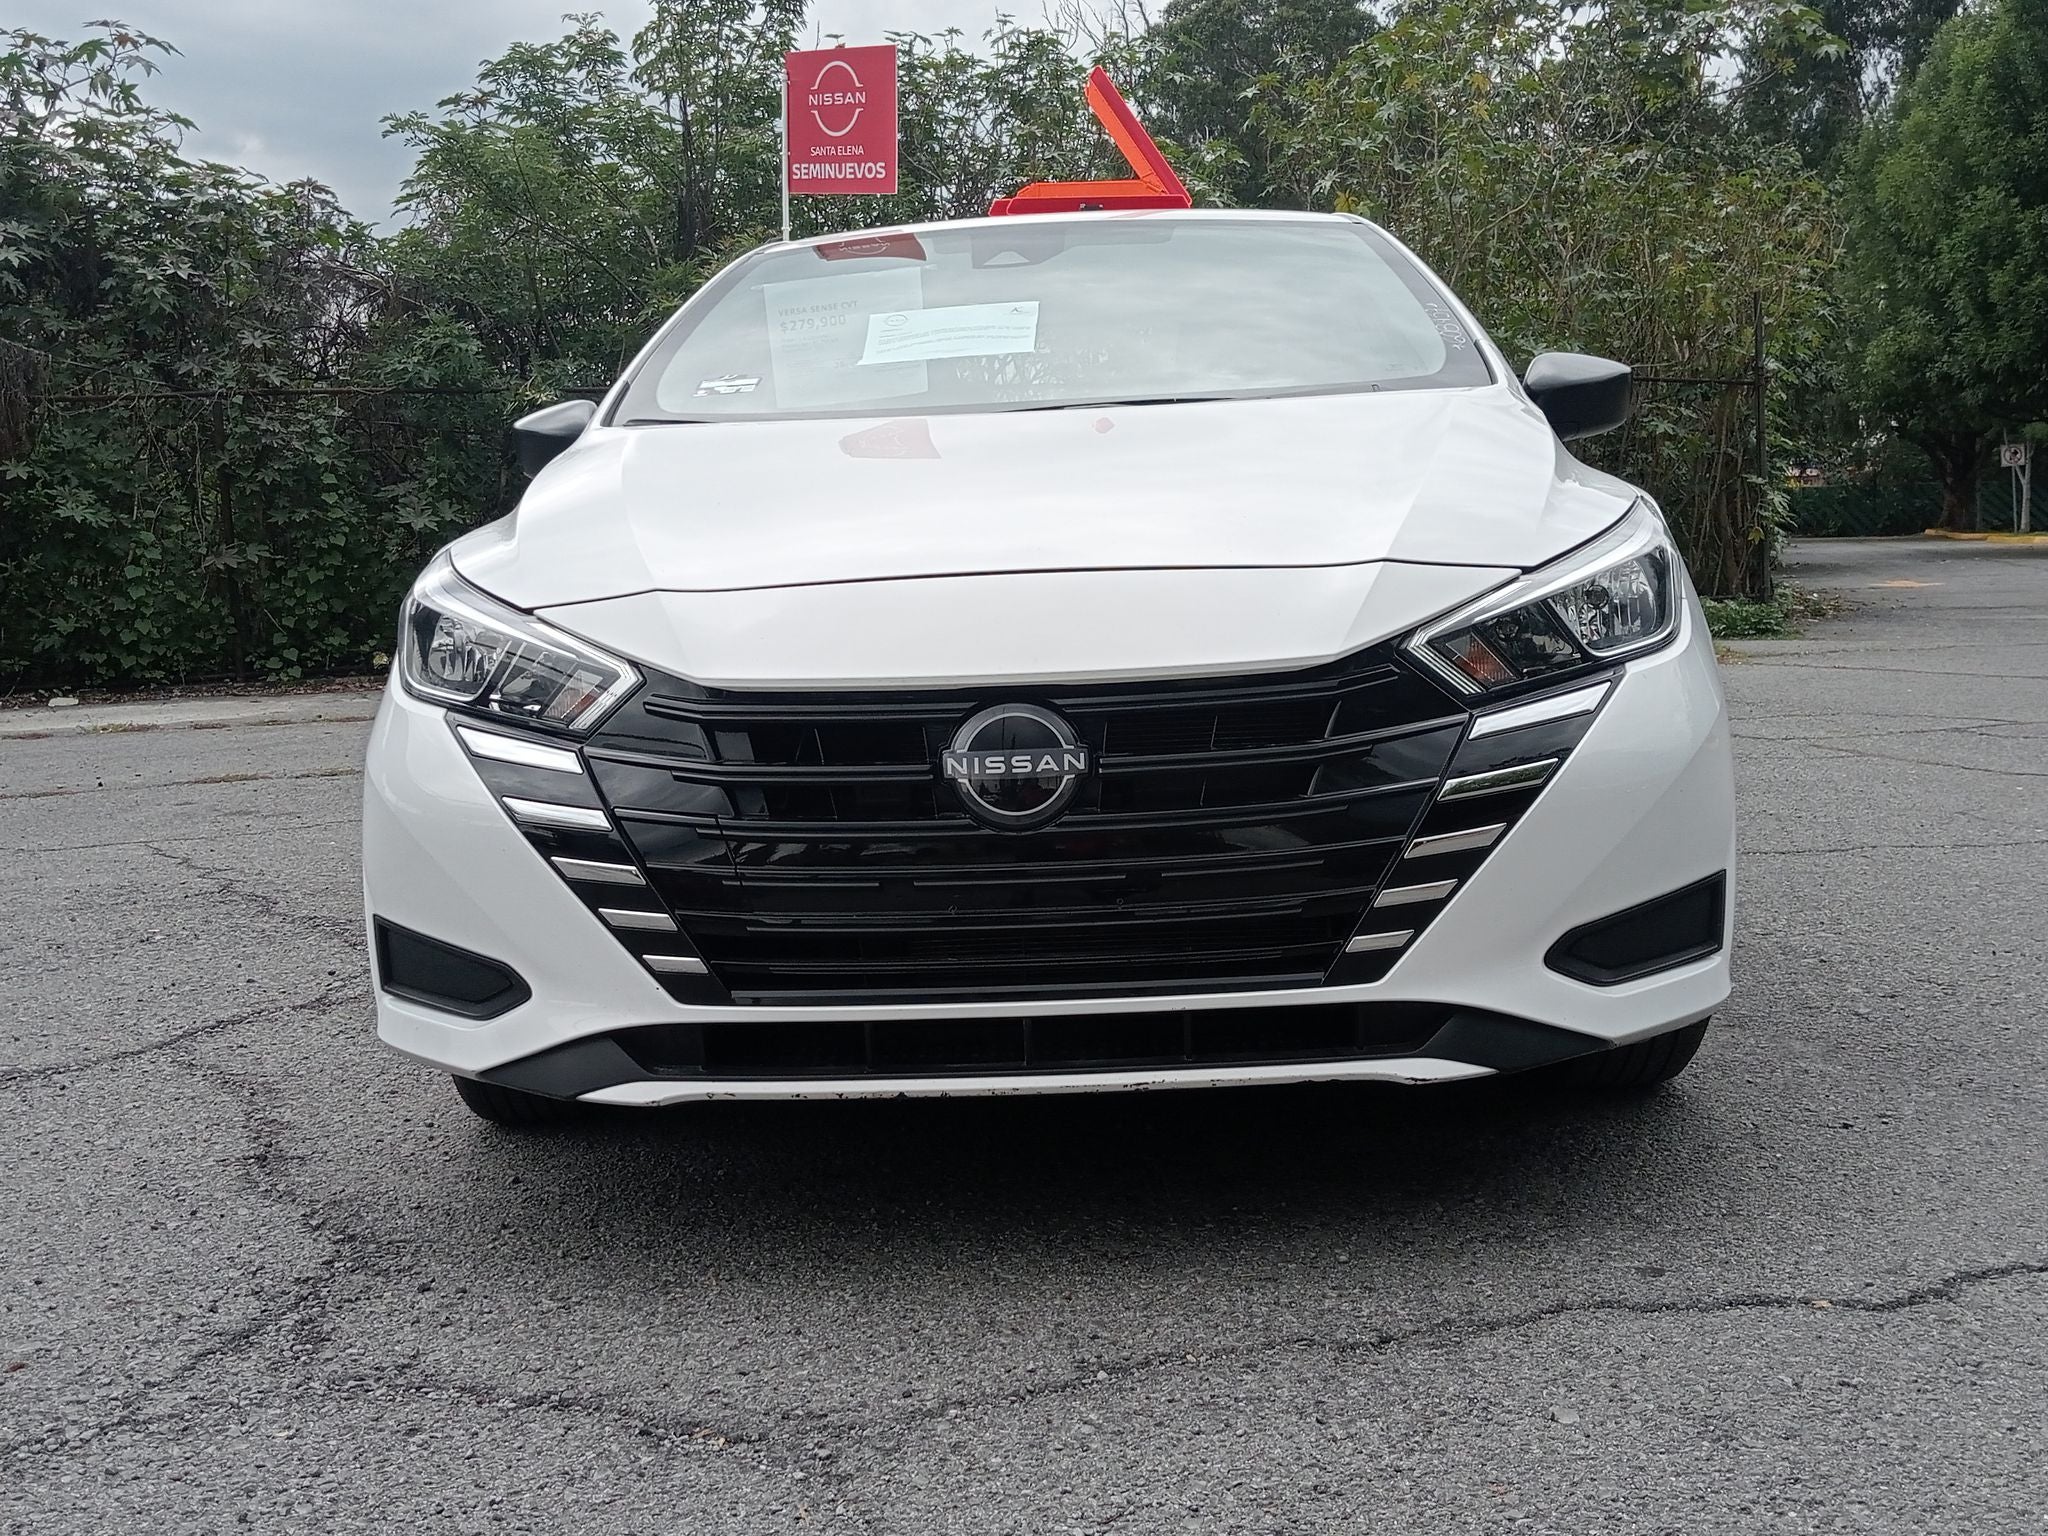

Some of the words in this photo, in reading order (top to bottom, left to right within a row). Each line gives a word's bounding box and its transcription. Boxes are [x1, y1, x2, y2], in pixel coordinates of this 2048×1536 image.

[809, 92, 866, 106] NISSAN
[810, 146, 836, 157] SANTA
[837, 145, 864, 156] ELENA
[792, 162, 886, 179] SEMINUEVOS
[778, 306, 808, 316] VERSA
[811, 303, 838, 313] SENSE
[841, 301, 858, 310] CVT
[780, 314, 847, 333] $279,900
[946, 752, 1086, 774] NISSAN
